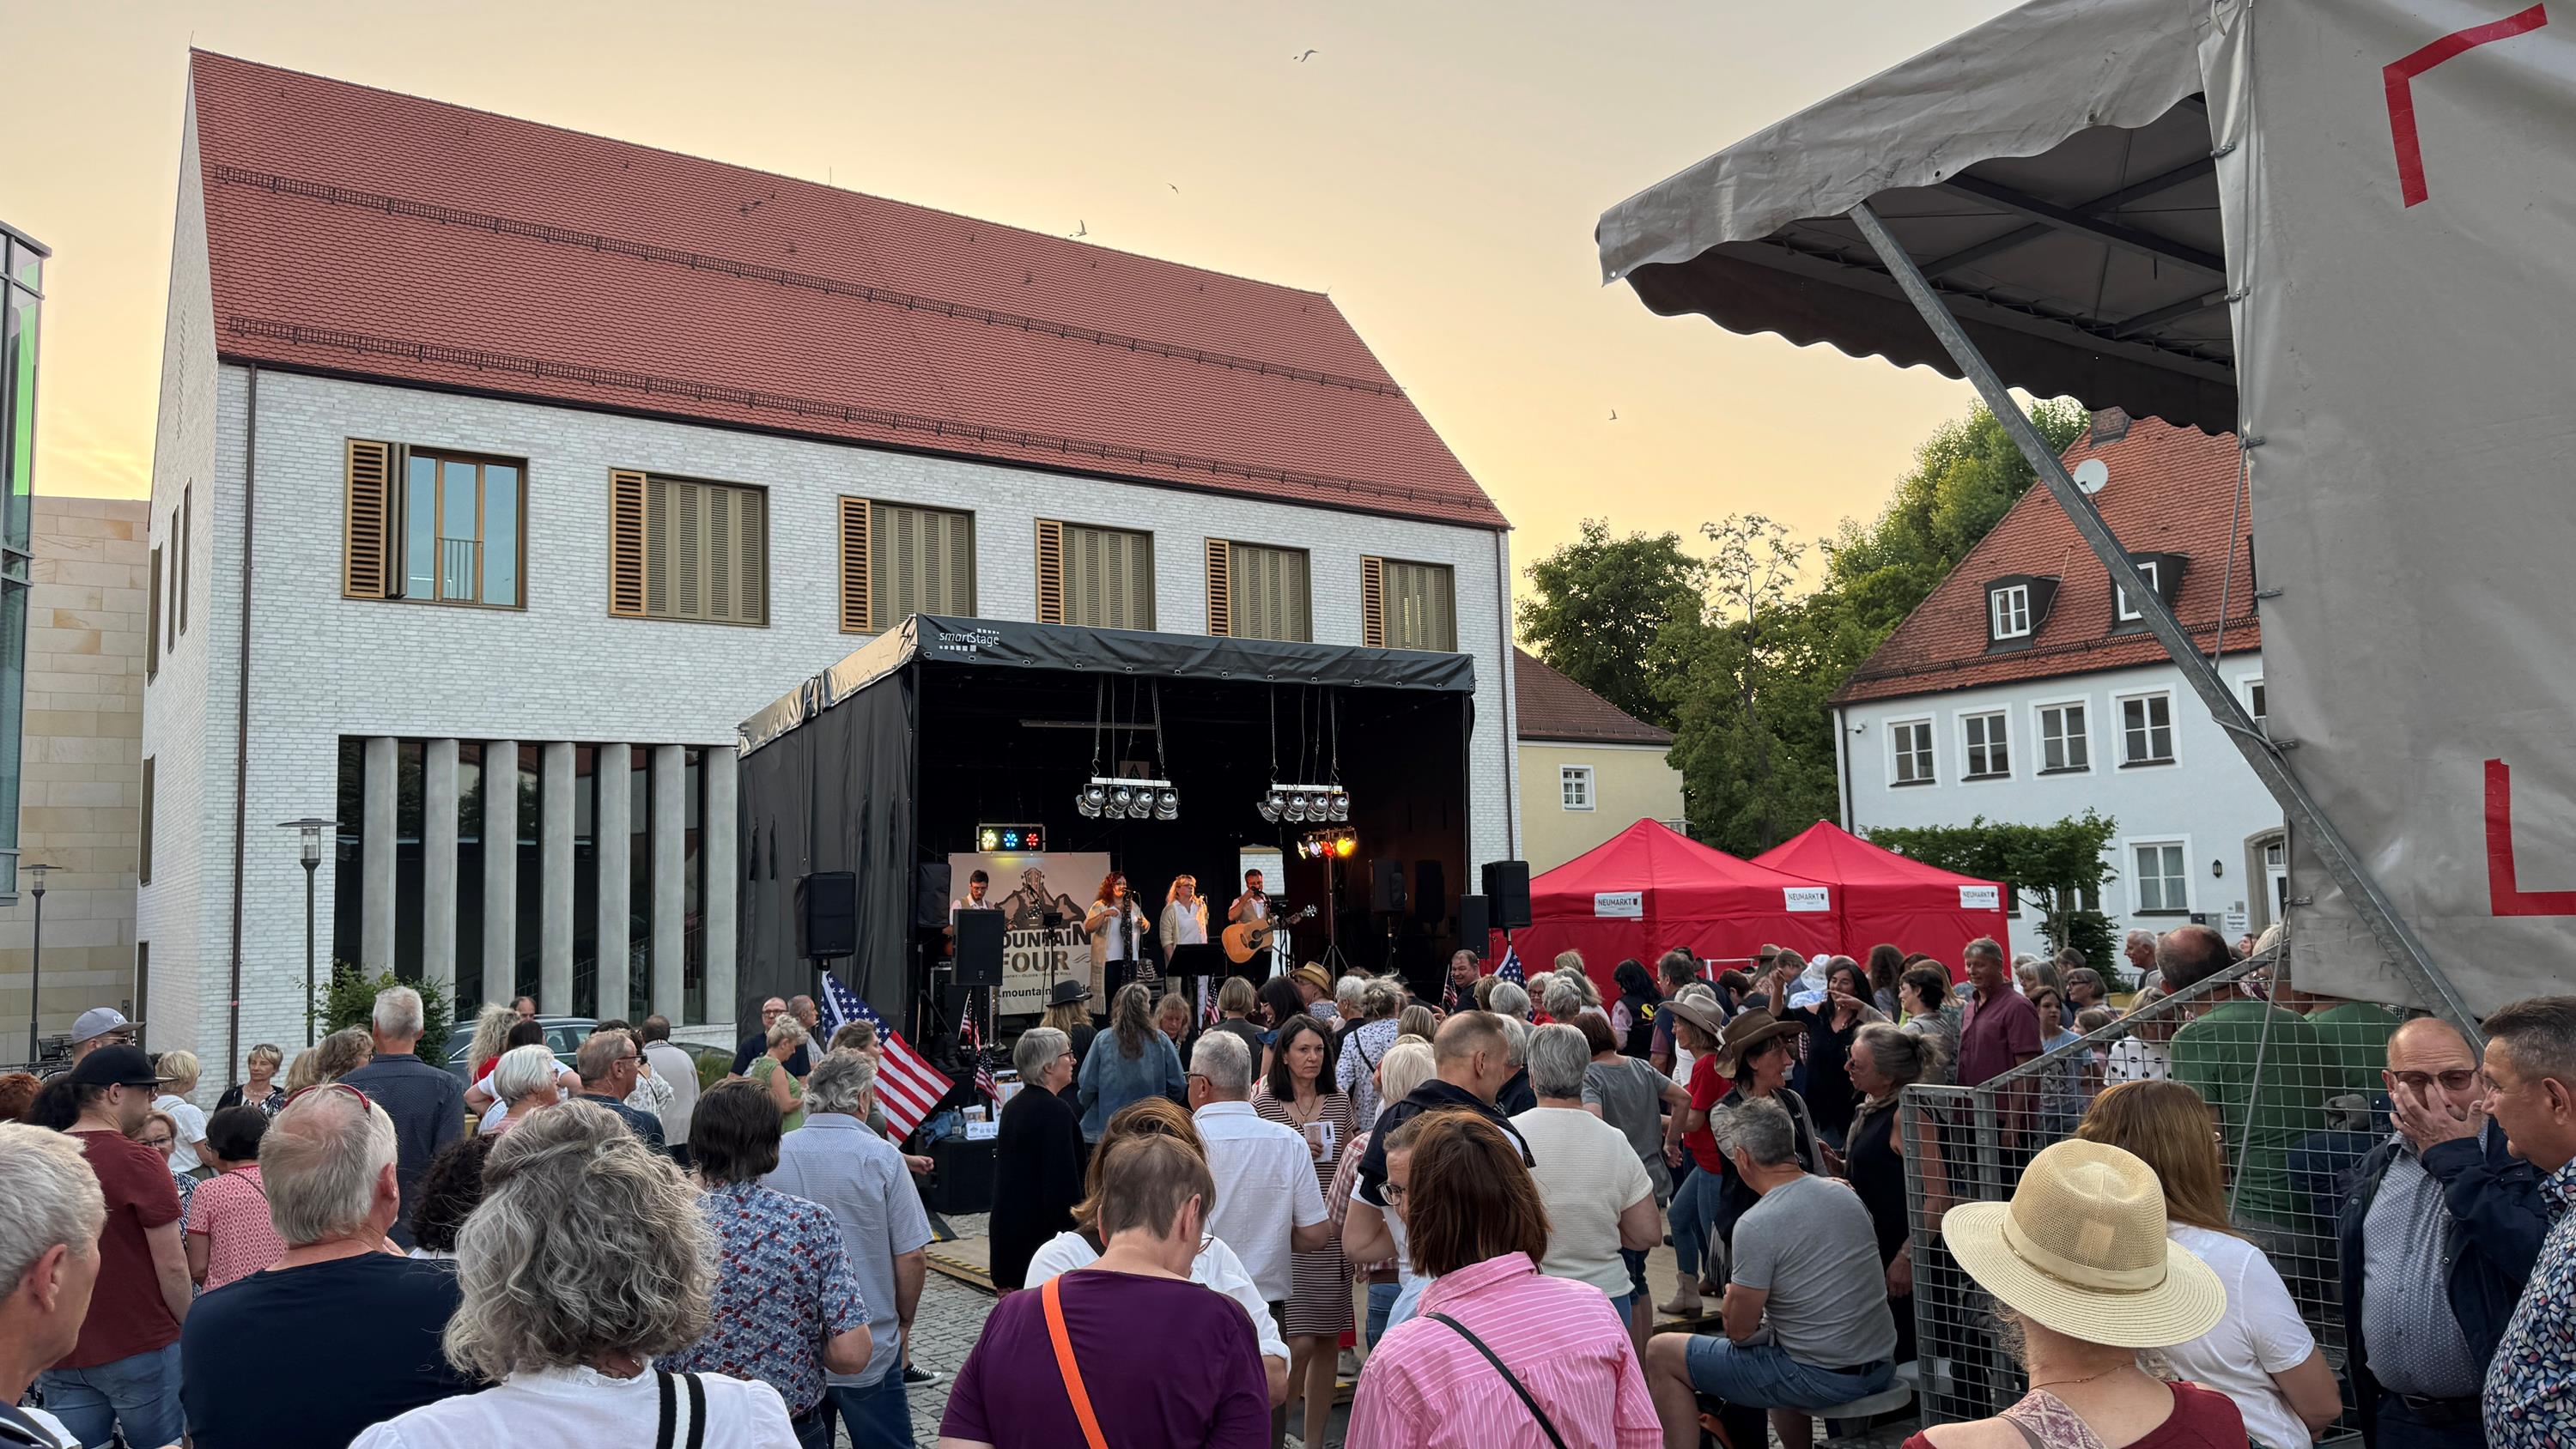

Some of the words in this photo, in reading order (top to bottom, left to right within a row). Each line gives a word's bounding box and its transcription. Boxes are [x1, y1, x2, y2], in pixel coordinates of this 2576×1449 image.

[939, 632, 999, 647] smartStage
[1598, 898, 1631, 906] NEUMARKT
[1003, 924, 1091, 949] OUNTAIN
